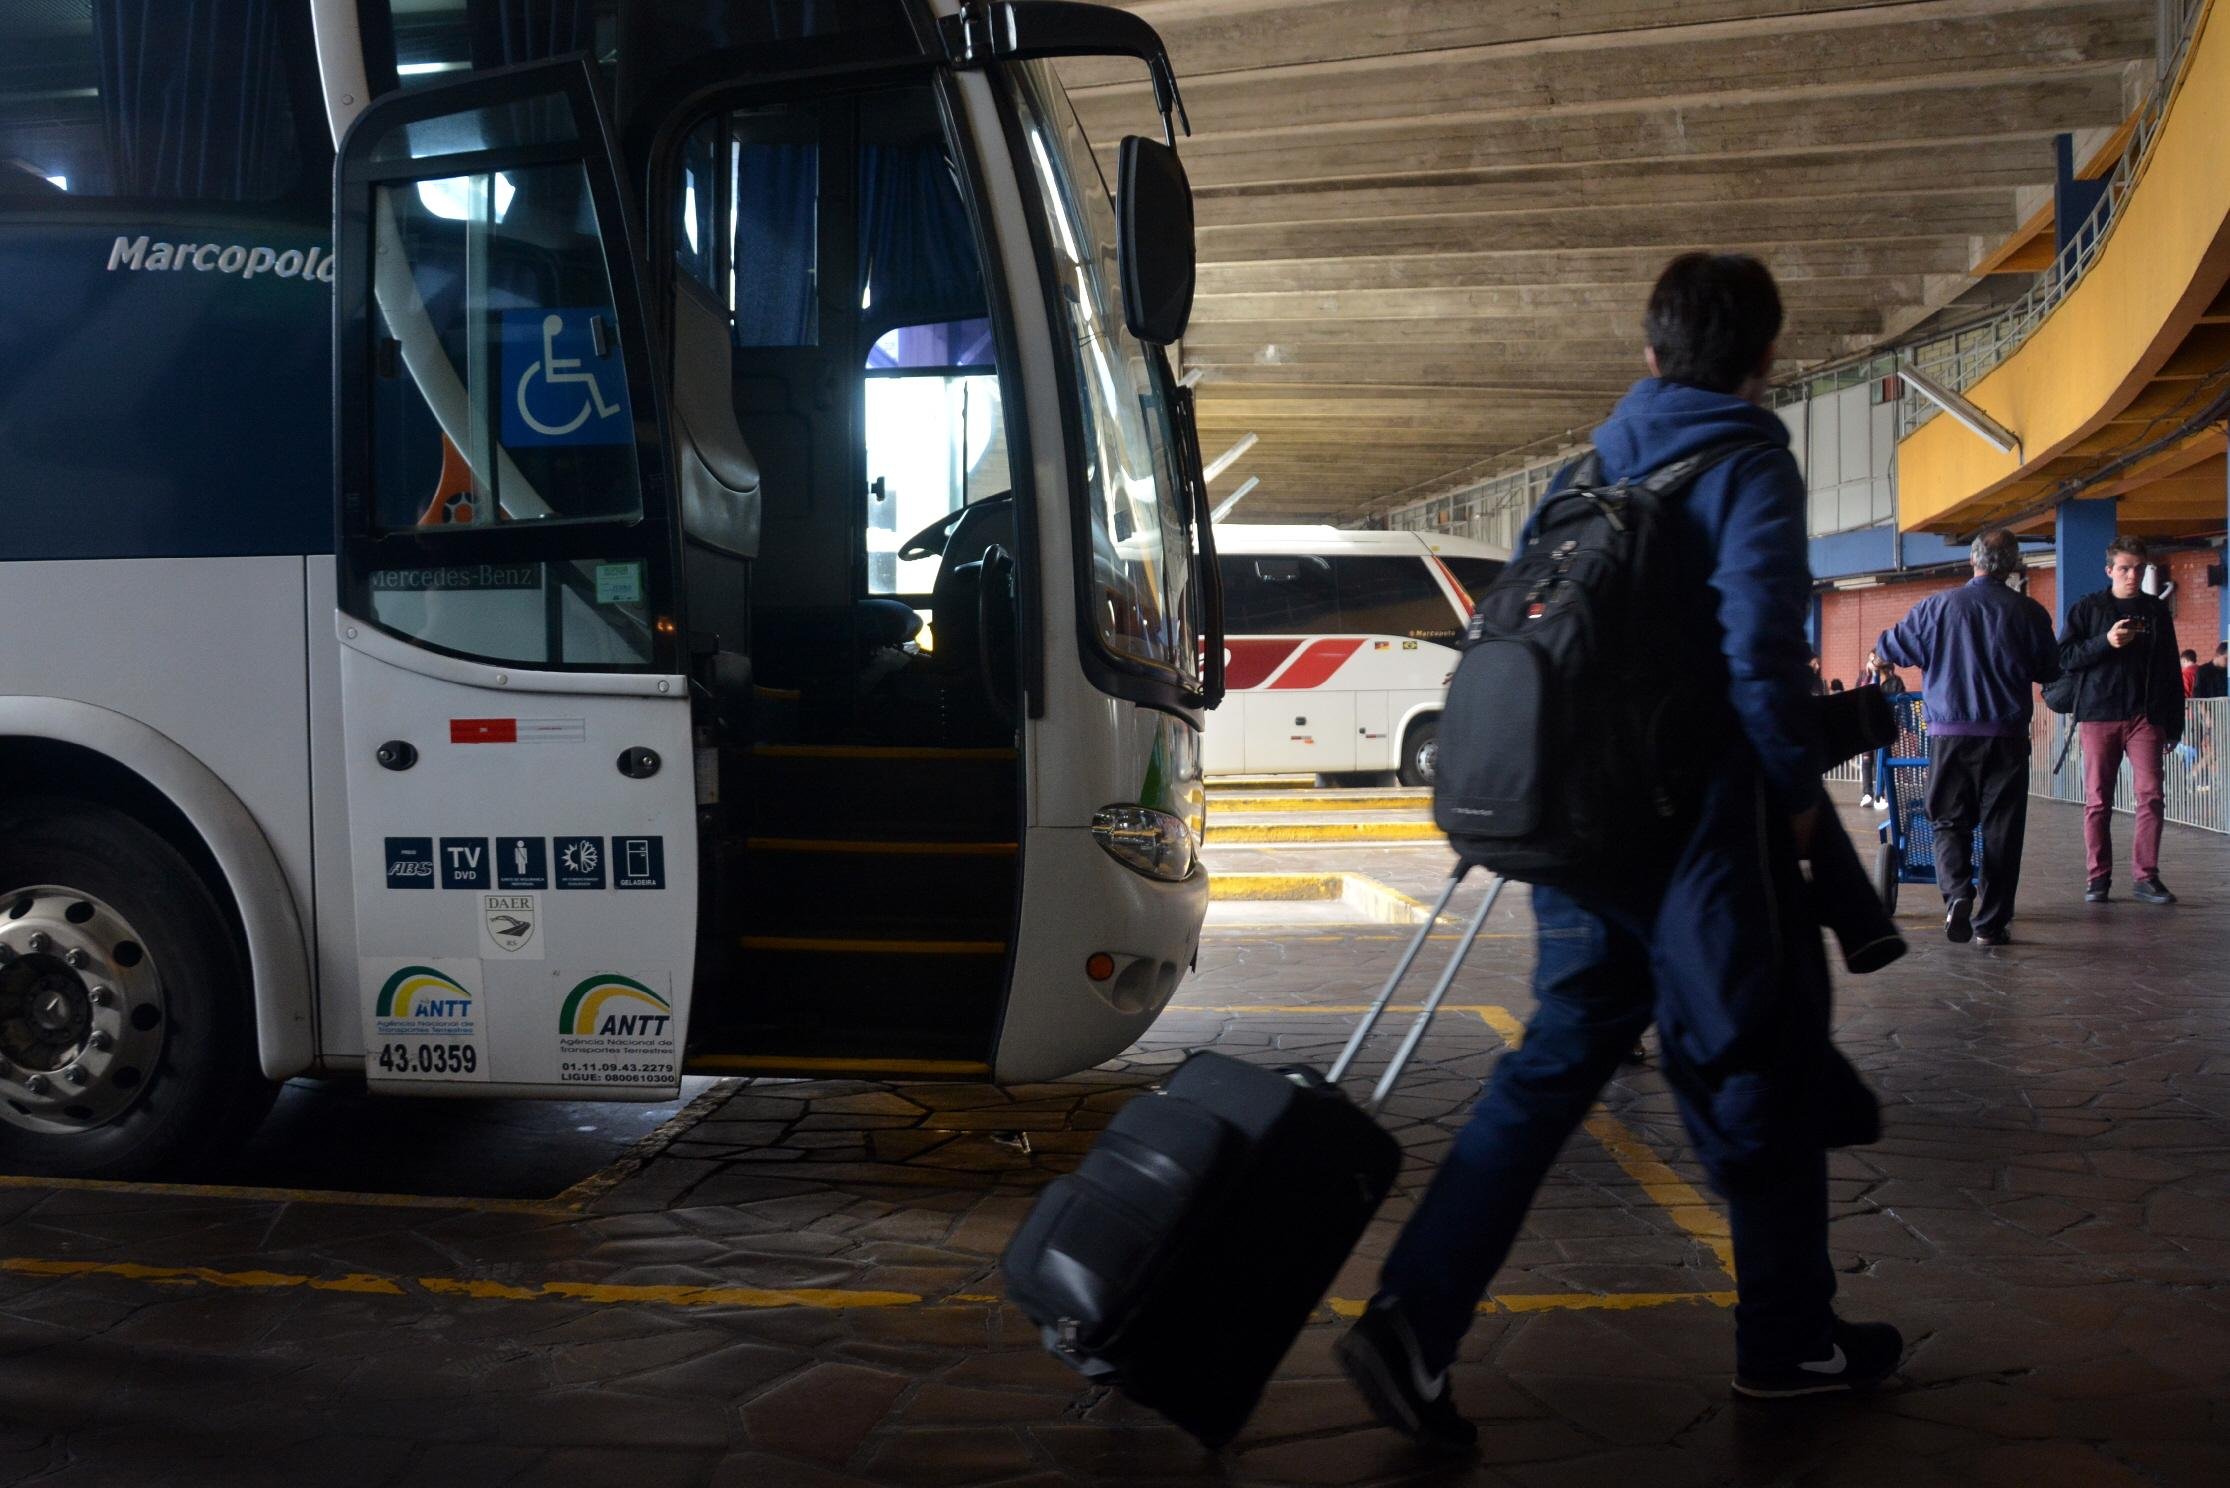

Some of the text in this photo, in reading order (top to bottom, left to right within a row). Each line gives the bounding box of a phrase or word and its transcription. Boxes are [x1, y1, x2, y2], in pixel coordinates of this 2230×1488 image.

[107, 236, 334, 282] Marcopolo
[447, 847, 481, 868] TV
[387, 861, 433, 876] ABS
[454, 871, 477, 880] DVD
[488, 897, 531, 909] DAER
[415, 1000, 472, 1017] ANTT
[600, 1015, 670, 1036] ANTT
[560, 1038, 605, 1046] Agência
[560, 1046, 620, 1054] Transportes
[380, 1044, 477, 1073] 43.0359
[562, 1063, 673, 1072] 01.11.09.43.2279
[561, 1073, 674, 1083] LIGUE: 0800610300
